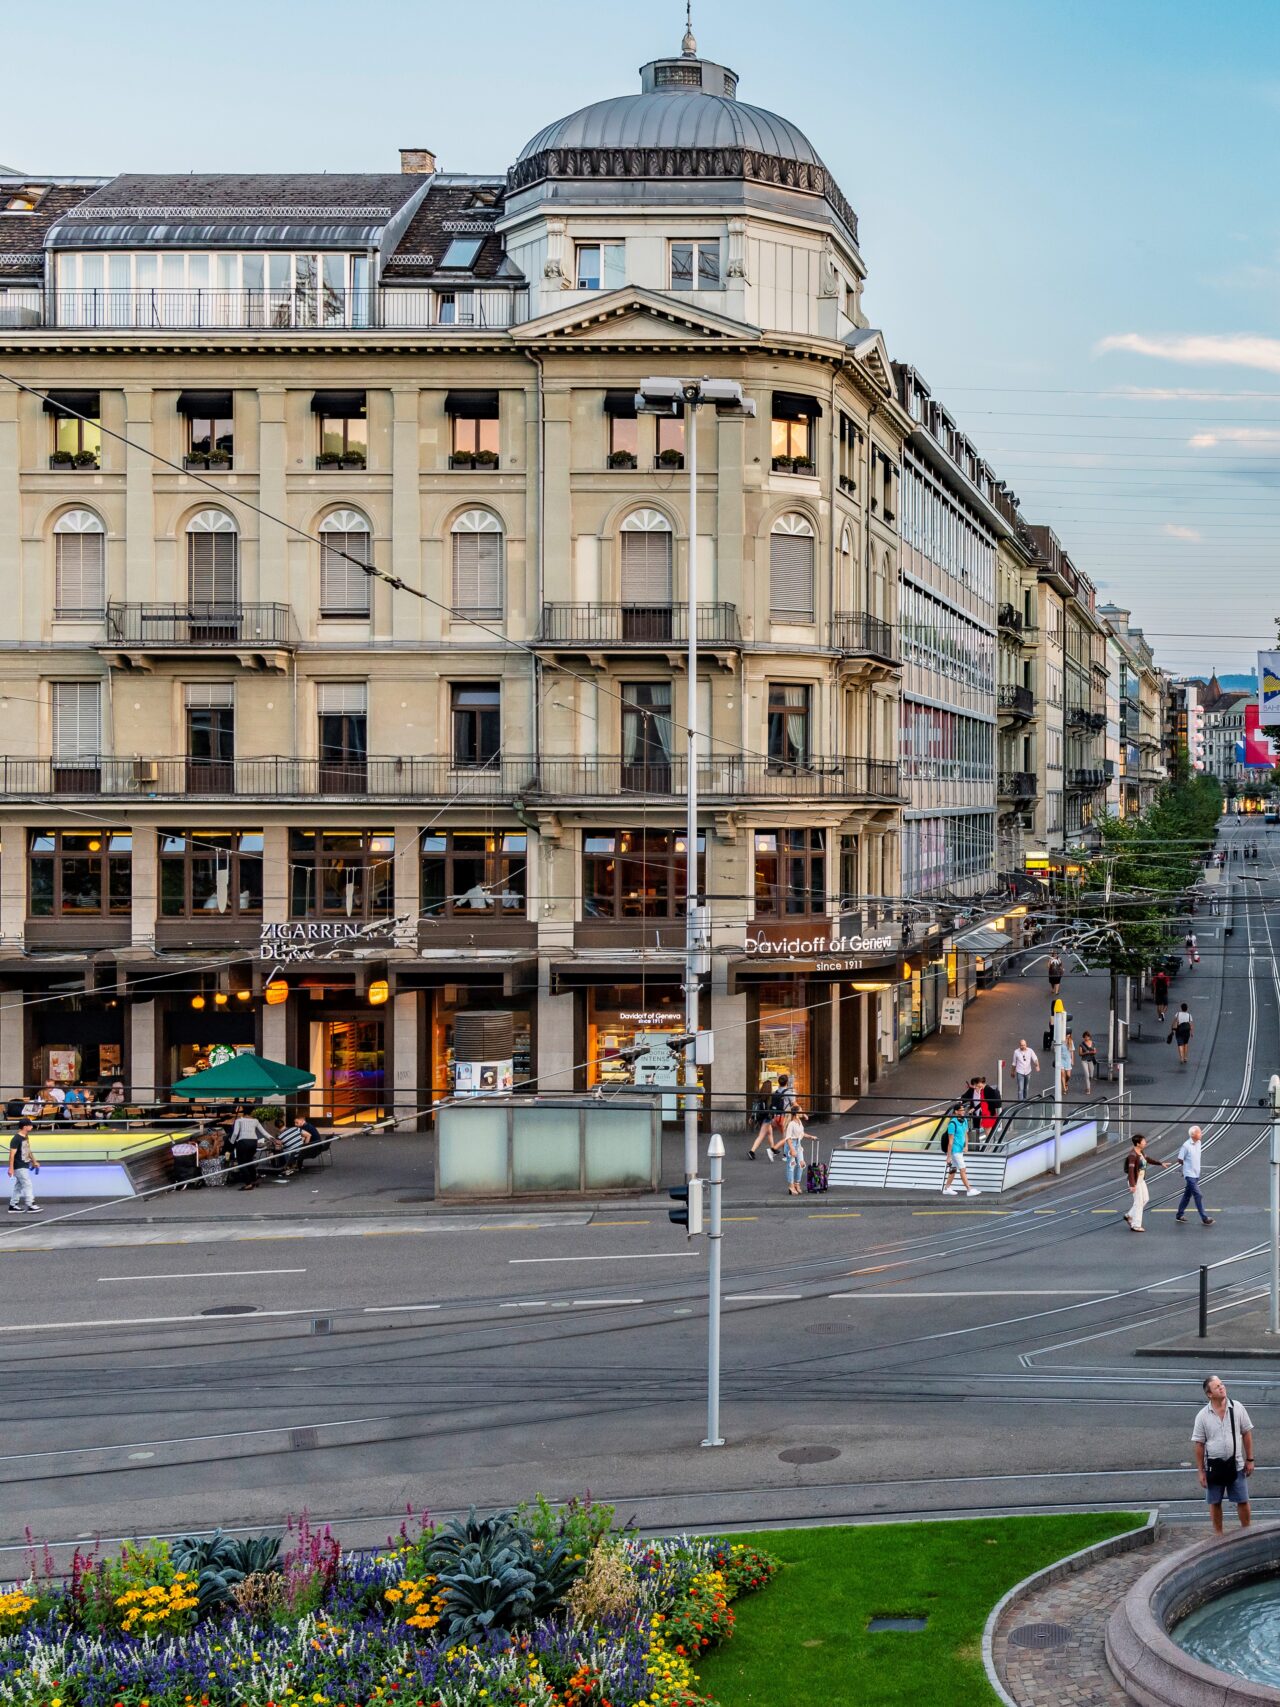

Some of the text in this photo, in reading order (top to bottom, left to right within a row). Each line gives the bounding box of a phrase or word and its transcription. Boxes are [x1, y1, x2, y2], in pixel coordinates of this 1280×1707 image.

[260, 923, 358, 939] ZIGARREN
[744, 935, 892, 954] Davidoff of Geneva
[816, 960, 864, 971] since 1911
